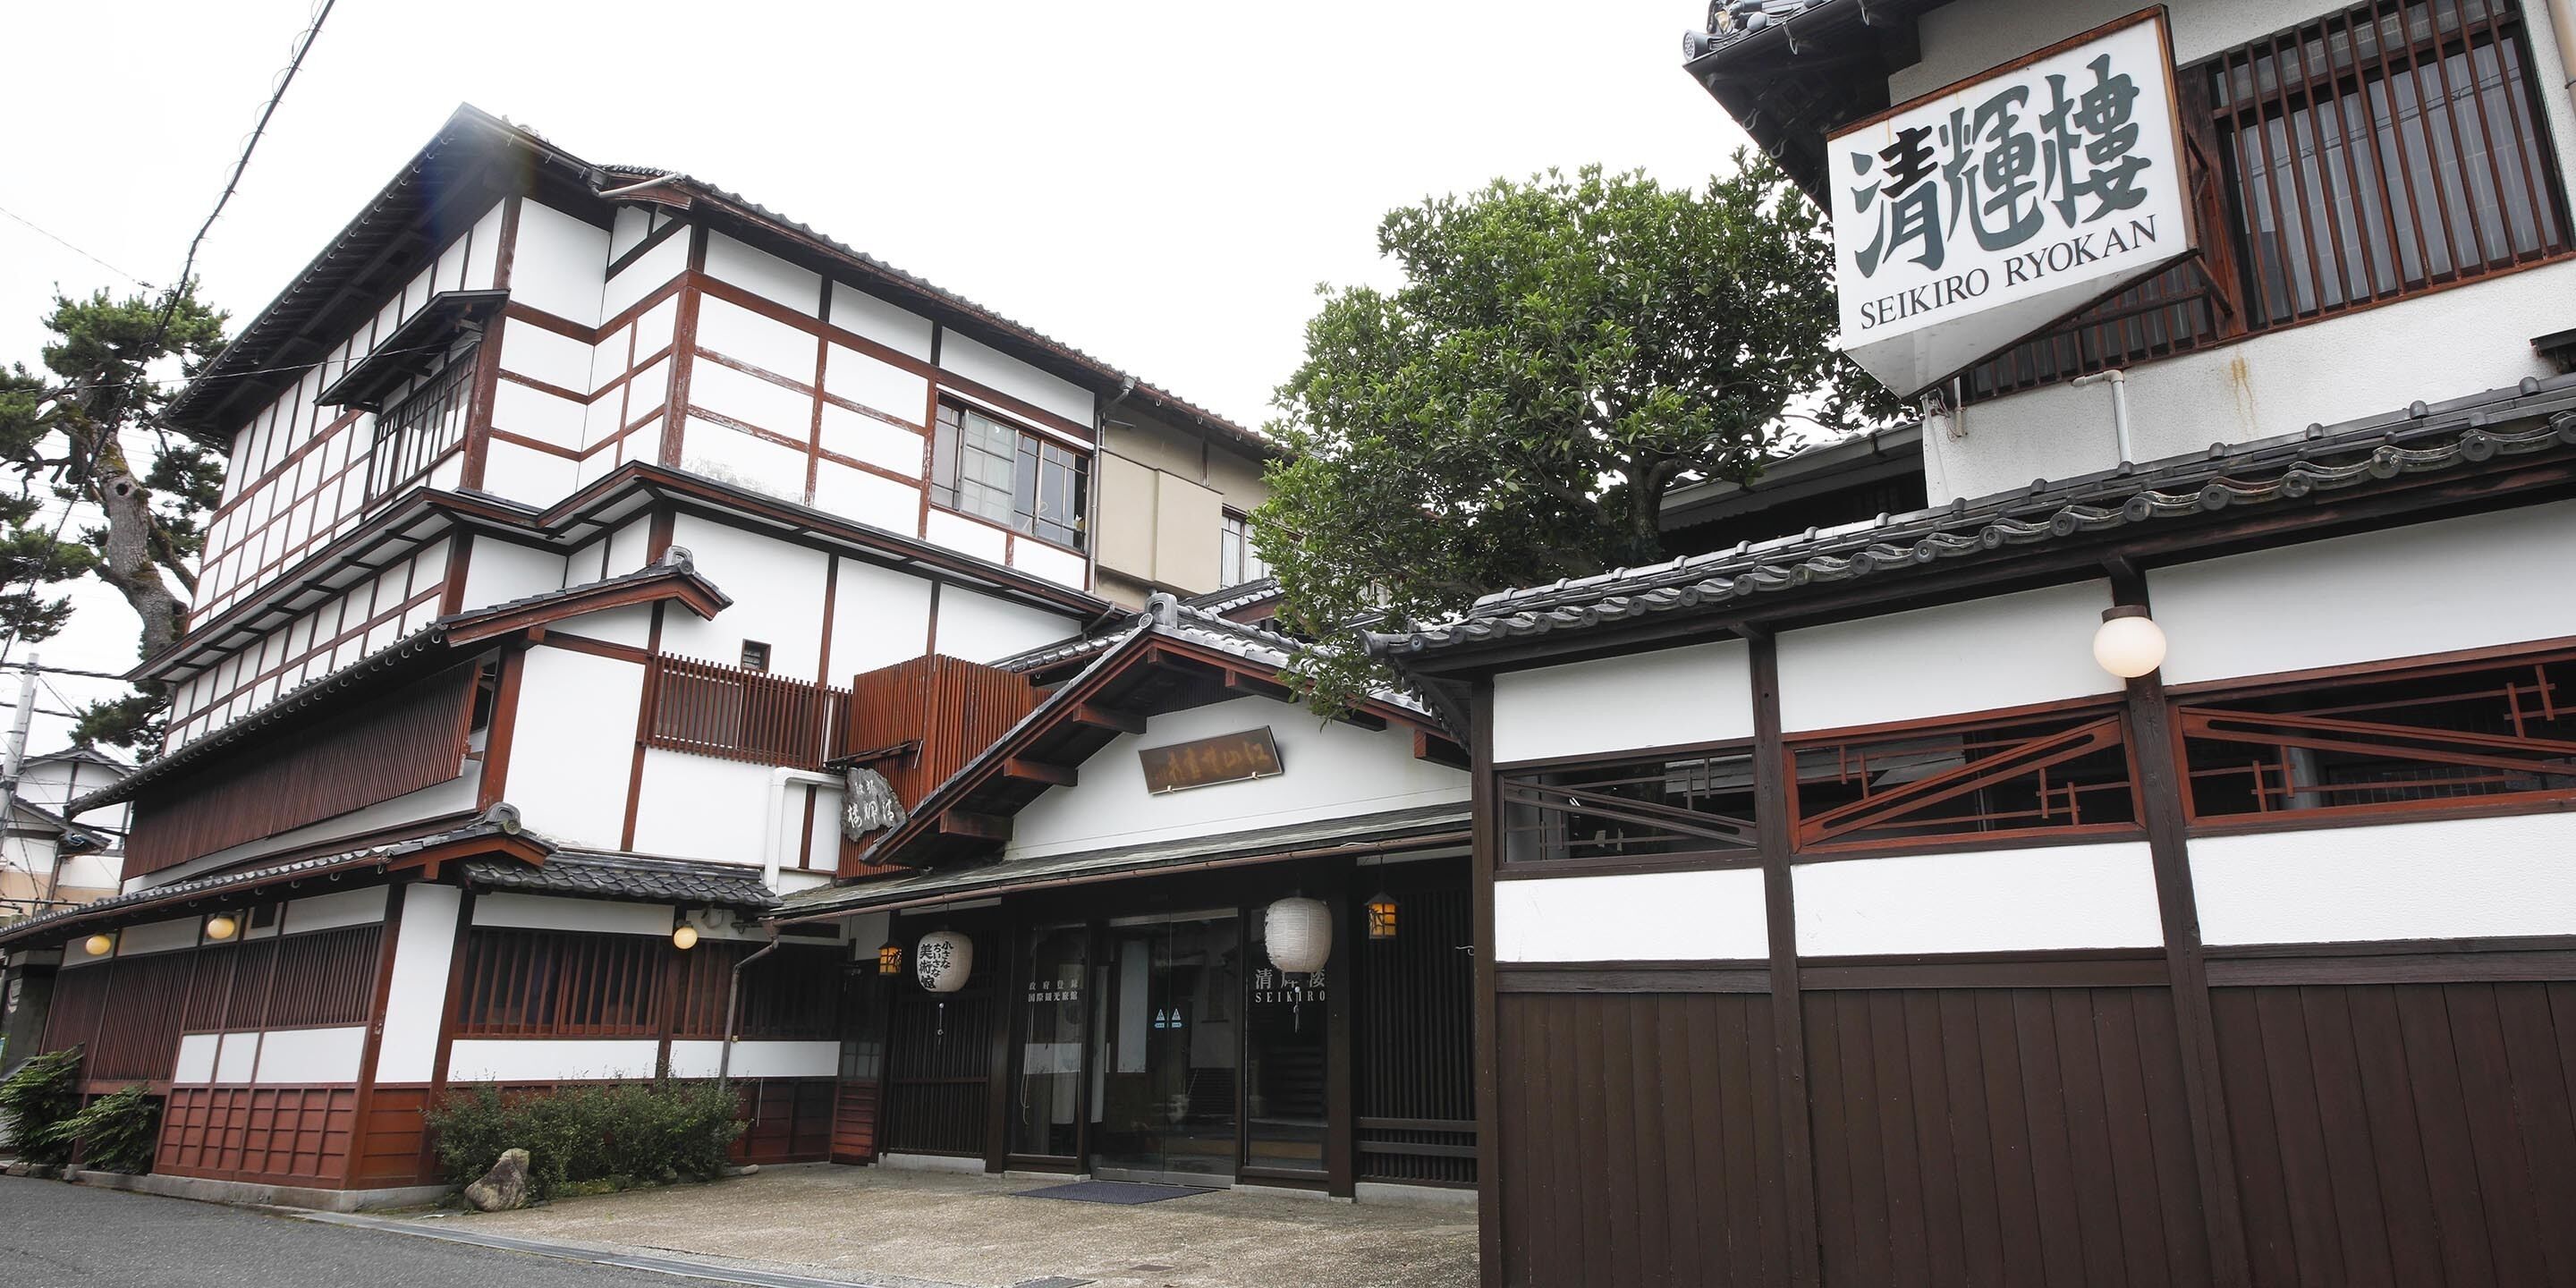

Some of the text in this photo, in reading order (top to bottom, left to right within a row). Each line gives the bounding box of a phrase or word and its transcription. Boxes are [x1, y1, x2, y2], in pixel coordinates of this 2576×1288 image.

[1860, 214, 2157, 331] SEIKIRO RYOKAN
[930, 943, 942, 978] ちいさな
[941, 940, 954, 970] 小さな
[1255, 990, 1326, 1004] SEIKIRO
